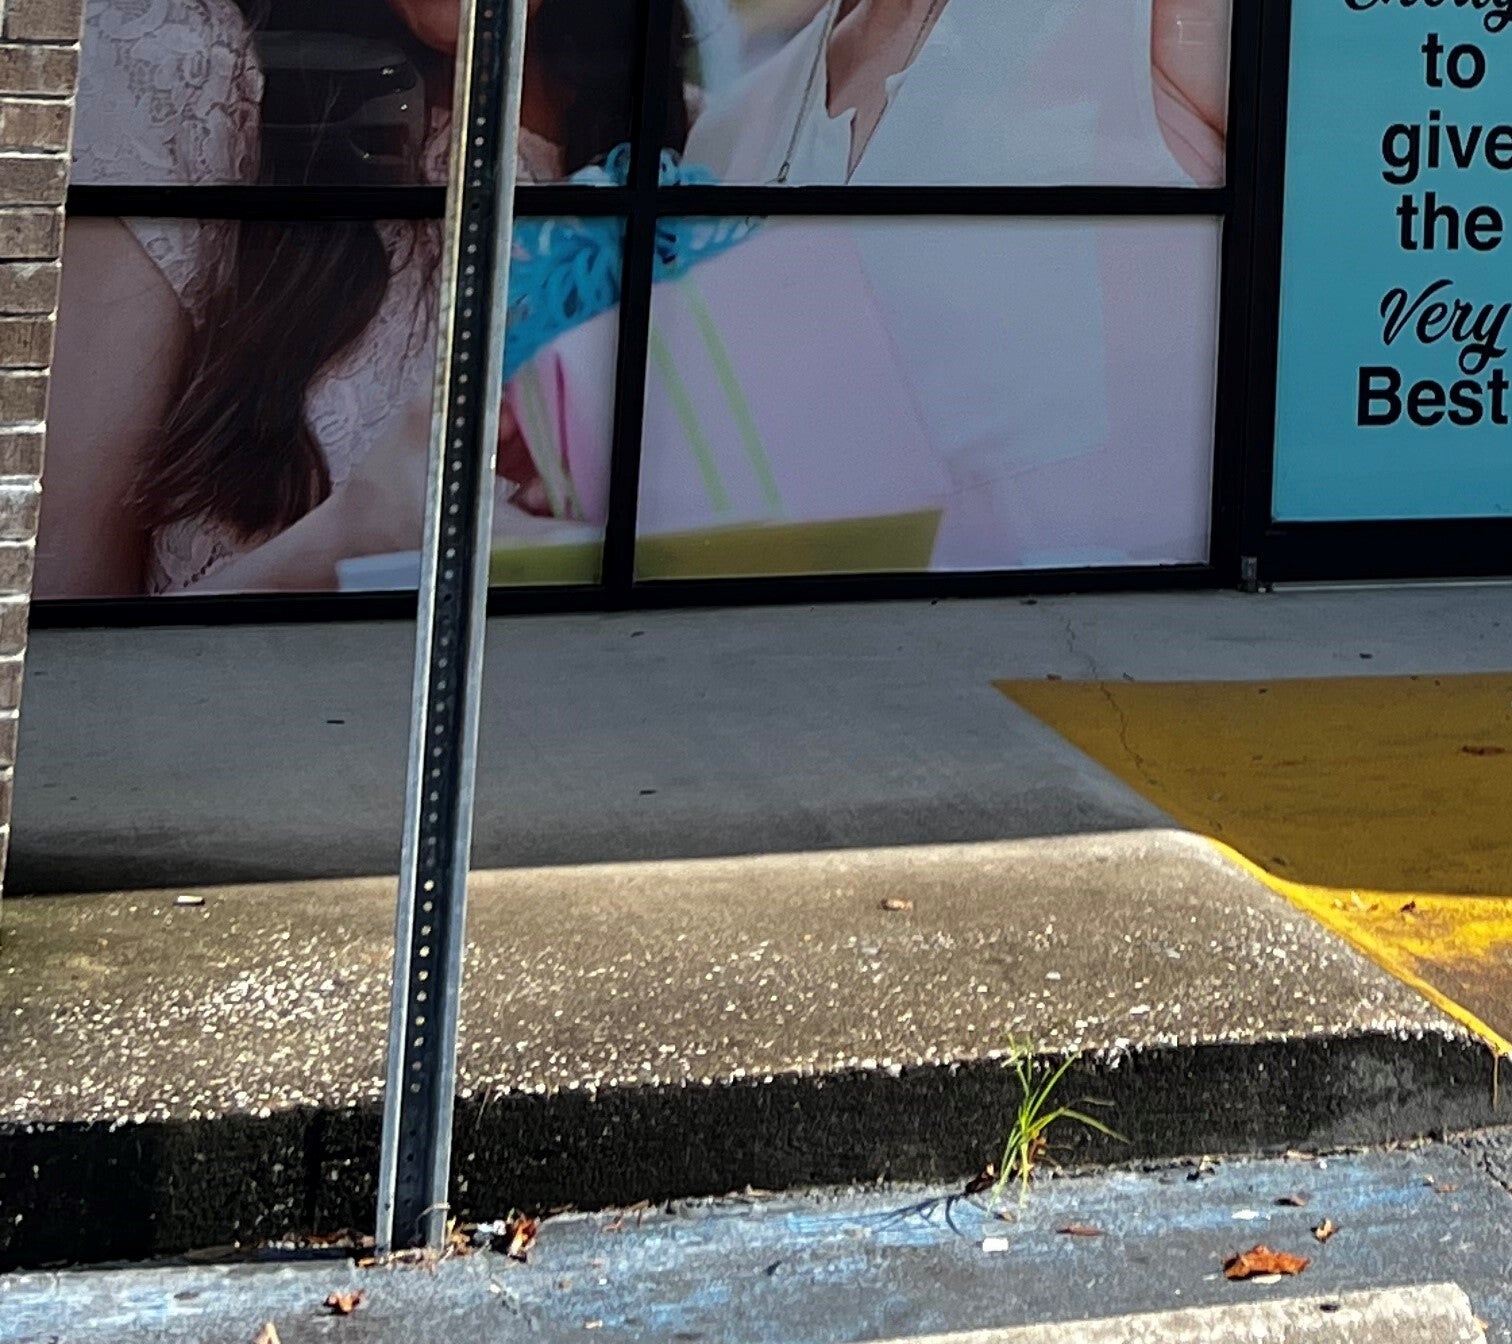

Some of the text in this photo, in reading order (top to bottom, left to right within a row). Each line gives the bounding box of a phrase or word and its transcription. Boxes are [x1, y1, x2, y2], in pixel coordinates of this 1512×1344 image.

[1421, 33, 1486, 89] to
[1396, 192, 1503, 251] the
[1380, 279, 1512, 375] Very
